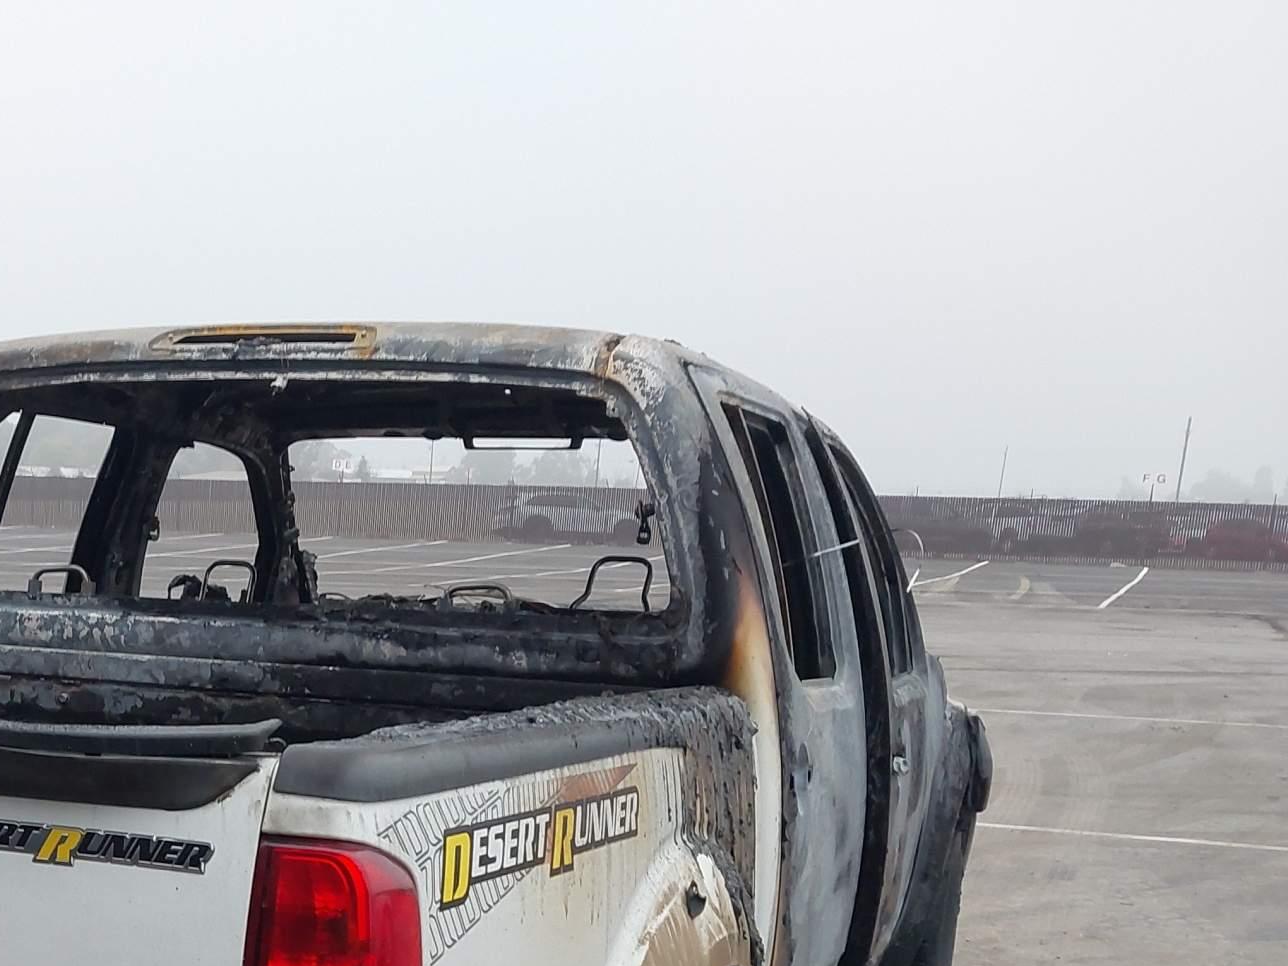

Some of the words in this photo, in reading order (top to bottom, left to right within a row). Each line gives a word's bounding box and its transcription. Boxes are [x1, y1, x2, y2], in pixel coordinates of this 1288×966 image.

[1142, 473, 1151, 483] F
[1156, 473, 1166, 484] G
[33, 826, 213, 873] RUNNER
[440, 812, 550, 908] DESERT
[550, 790, 640, 874] RUNNER
